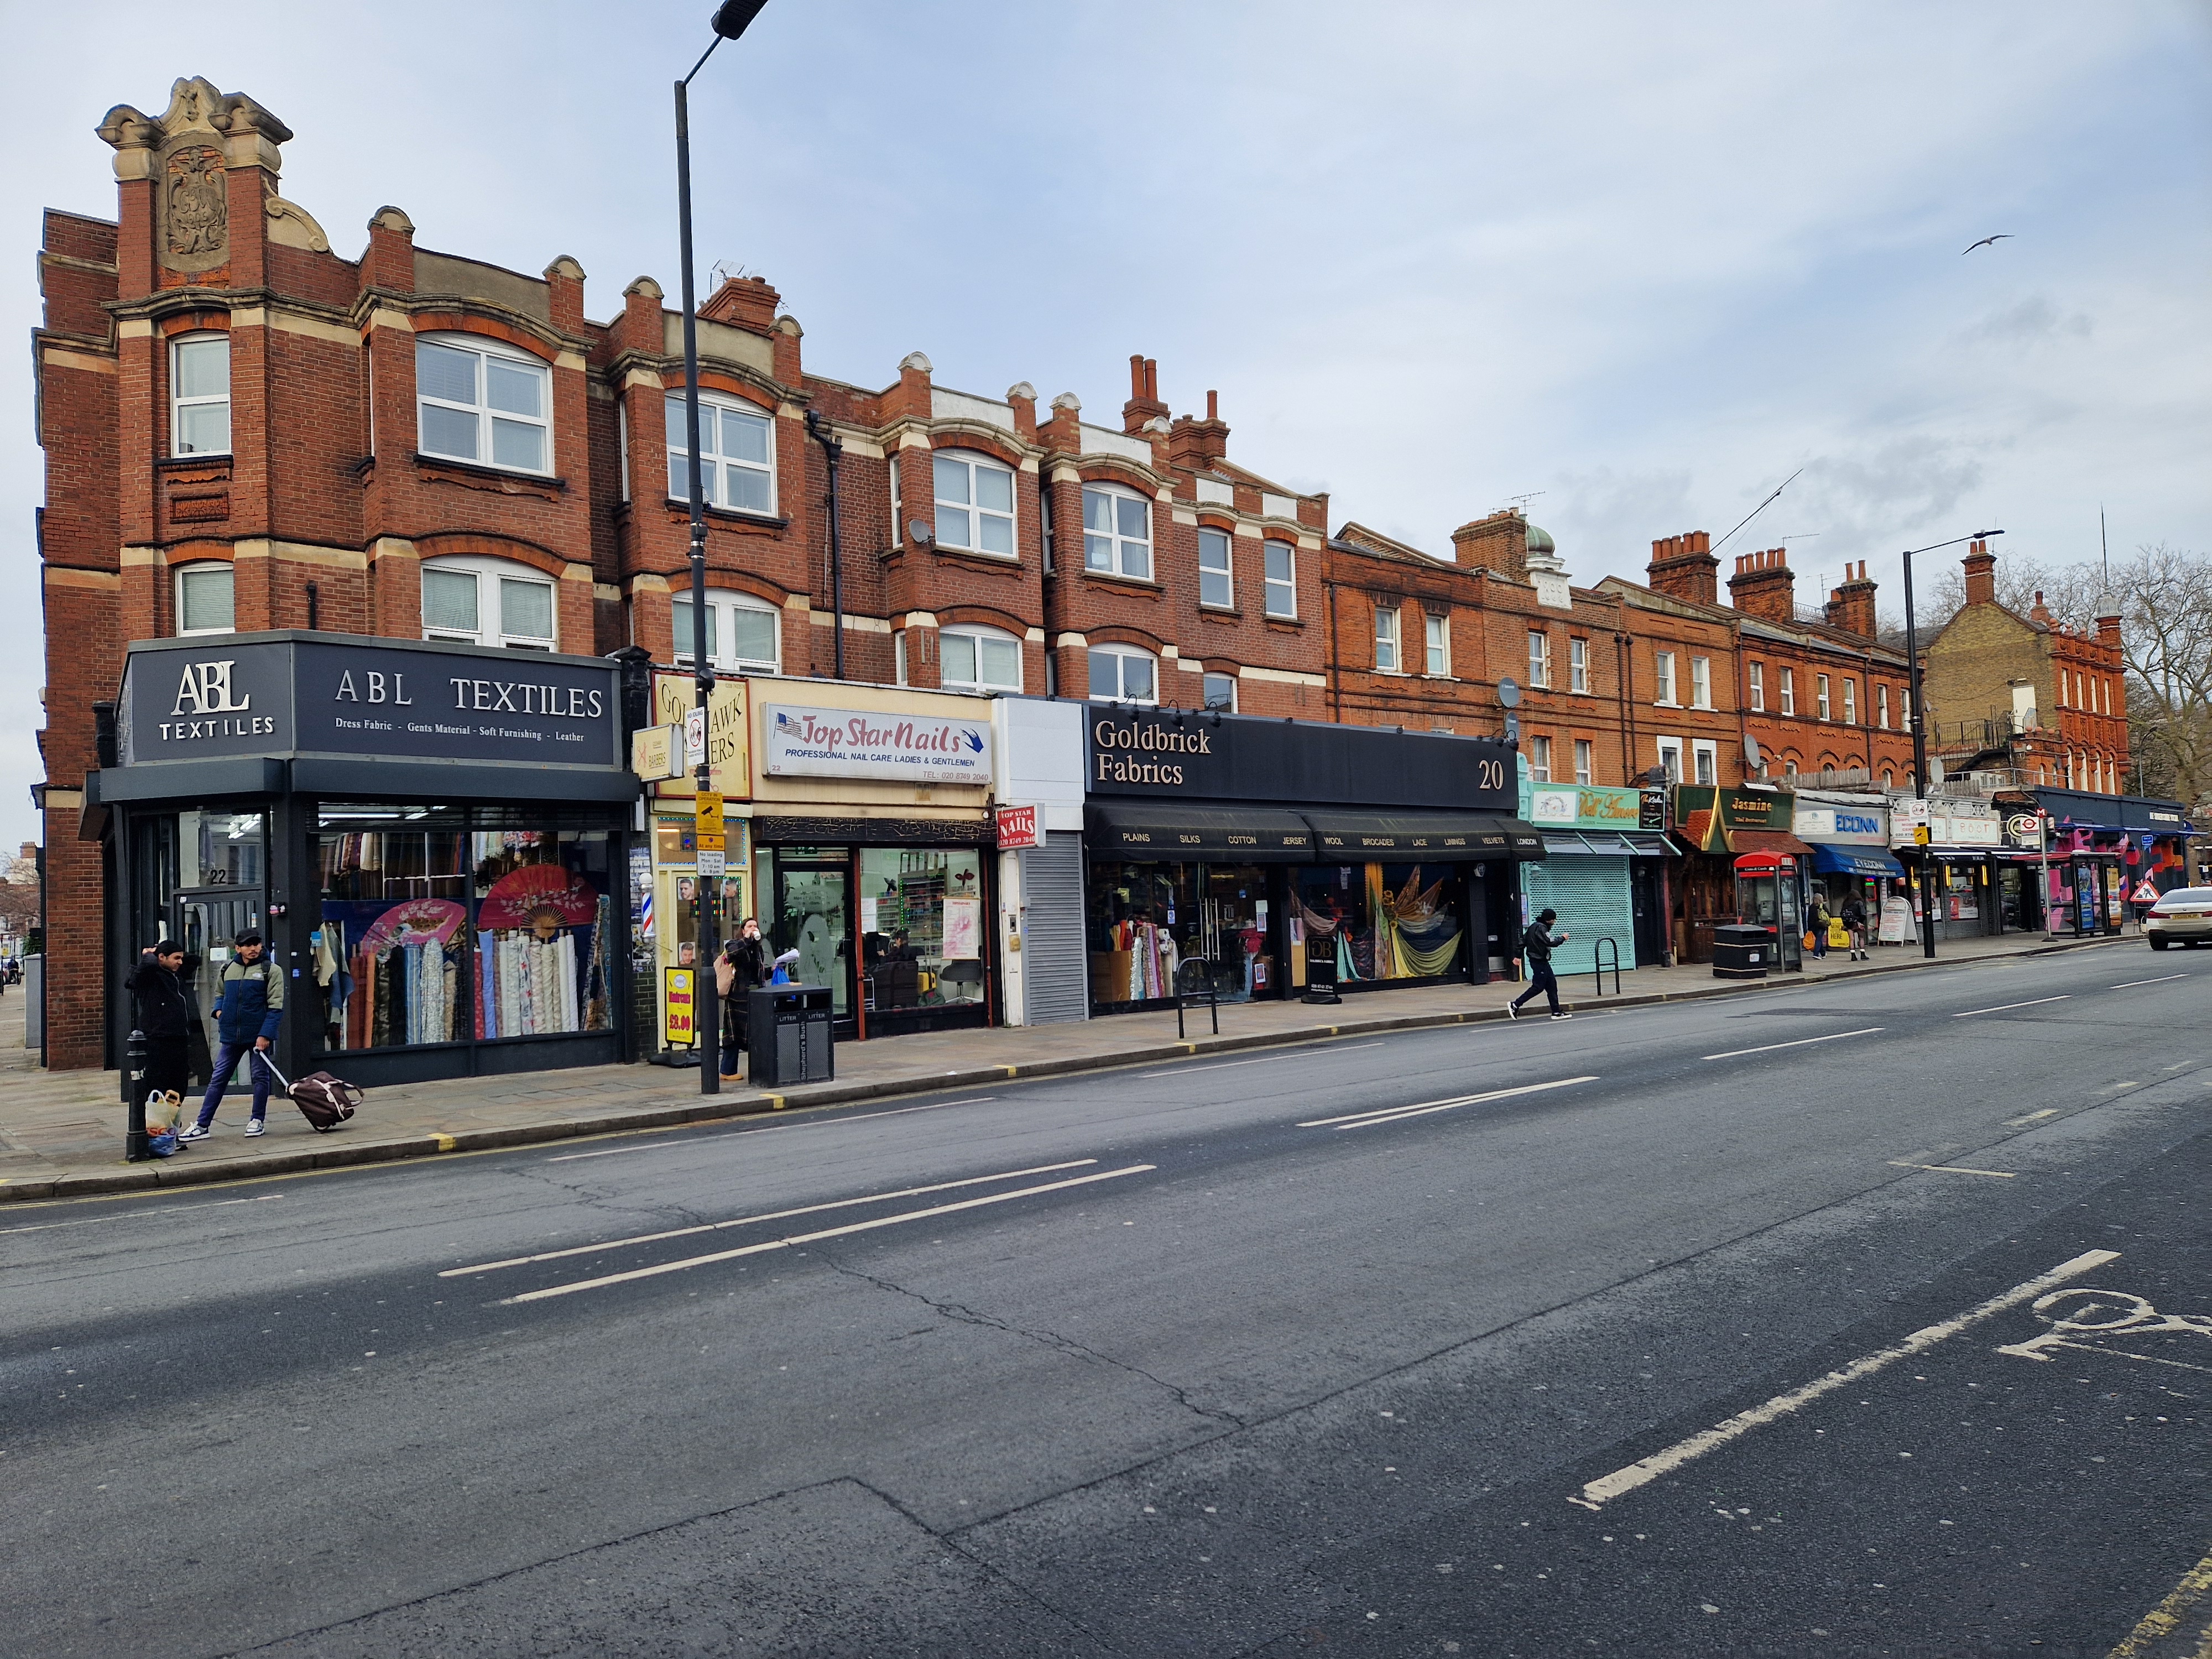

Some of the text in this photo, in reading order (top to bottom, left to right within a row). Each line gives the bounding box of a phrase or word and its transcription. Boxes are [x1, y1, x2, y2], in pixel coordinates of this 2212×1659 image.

[170, 660, 250, 716] ABL
[335, 669, 602, 718] ABL TEXTILES
[159, 717, 274, 740] TEXTILES
[335, 718, 361, 728] Dress
[364, 719, 392, 731] Fabric
[408, 722, 432, 733] Gents
[435, 724, 471, 735] Material
[479, 726, 497, 736] Soft
[499, 728, 542, 741] Furnishing
[555, 731, 585, 742] Leather
[802, 715, 961, 753] Top Star Nails
[1095, 721, 1212, 754] Goldbrick
[649, 752, 666, 767] BARBERS
[785, 749, 847, 760] PROFESSIONAL
[851, 753, 868, 761] NAIL
[871, 754, 891, 763] CARE
[895, 755, 921, 764] LADIES
[932, 758, 975, 767] GENTLEMEN
[973, 773, 988, 781] 2040
[1097, 753, 1183, 785] Fabrics
[1478, 760, 1504, 790] 20
[1732, 797, 1772, 811] Jasmine
[999, 817, 1034, 838] NAILS
[1123, 833, 1307, 845] PLAINS SILKS COTTON JERSEY
[1324, 837, 1343, 845] WOOL
[1362, 838, 1394, 846] BROCADES
[1854, 858, 1887, 870] EYECONN
[211, 869, 226, 884] 22
[669, 991, 691, 1004] Haircuts
